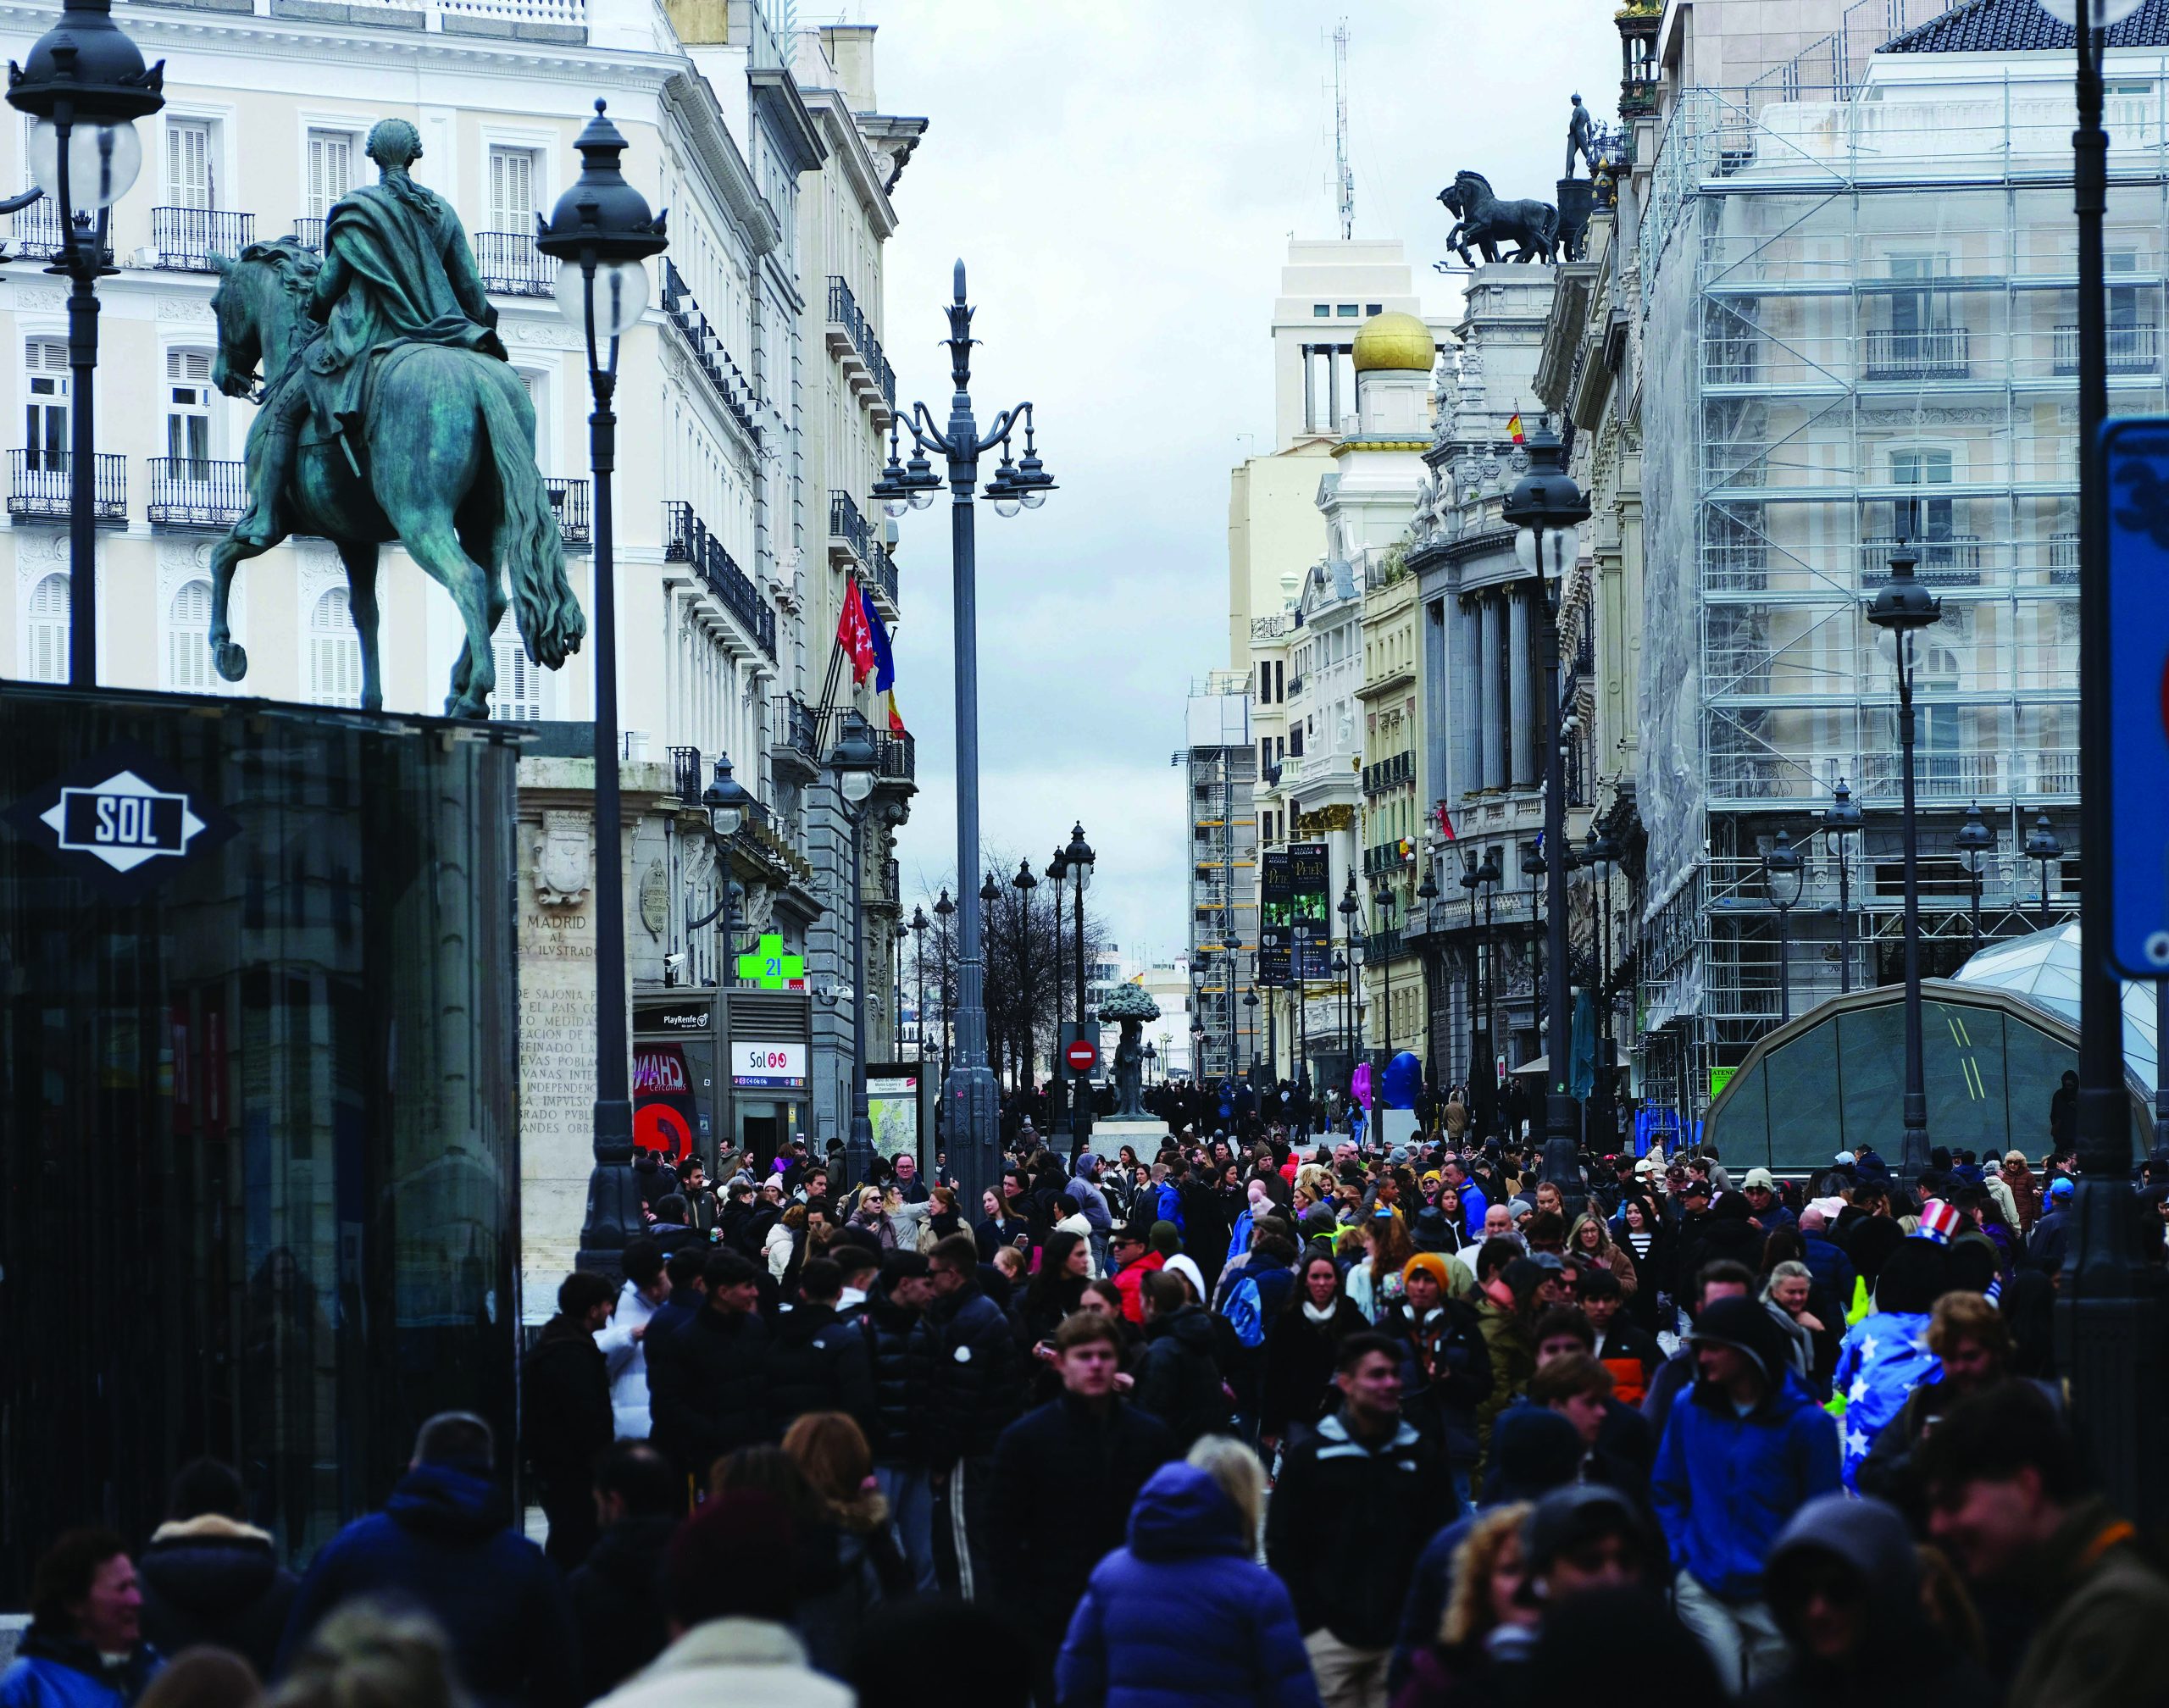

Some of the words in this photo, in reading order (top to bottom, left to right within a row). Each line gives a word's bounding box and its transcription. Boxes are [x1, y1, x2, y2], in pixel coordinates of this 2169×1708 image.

[95, 796, 158, 846] SOL
[527, 915, 586, 929] MADRID
[549, 932, 565, 943] AL
[765, 958, 781, 976] 21
[530, 1002, 543, 1013] EL
[663, 1014, 696, 1025] PlayRenfe
[569, 1030, 584, 1040] DE
[750, 1051, 767, 1068] Sol
[543, 1095, 591, 1106] IMPVLSO
[519, 1123, 559, 1134] ANDES
